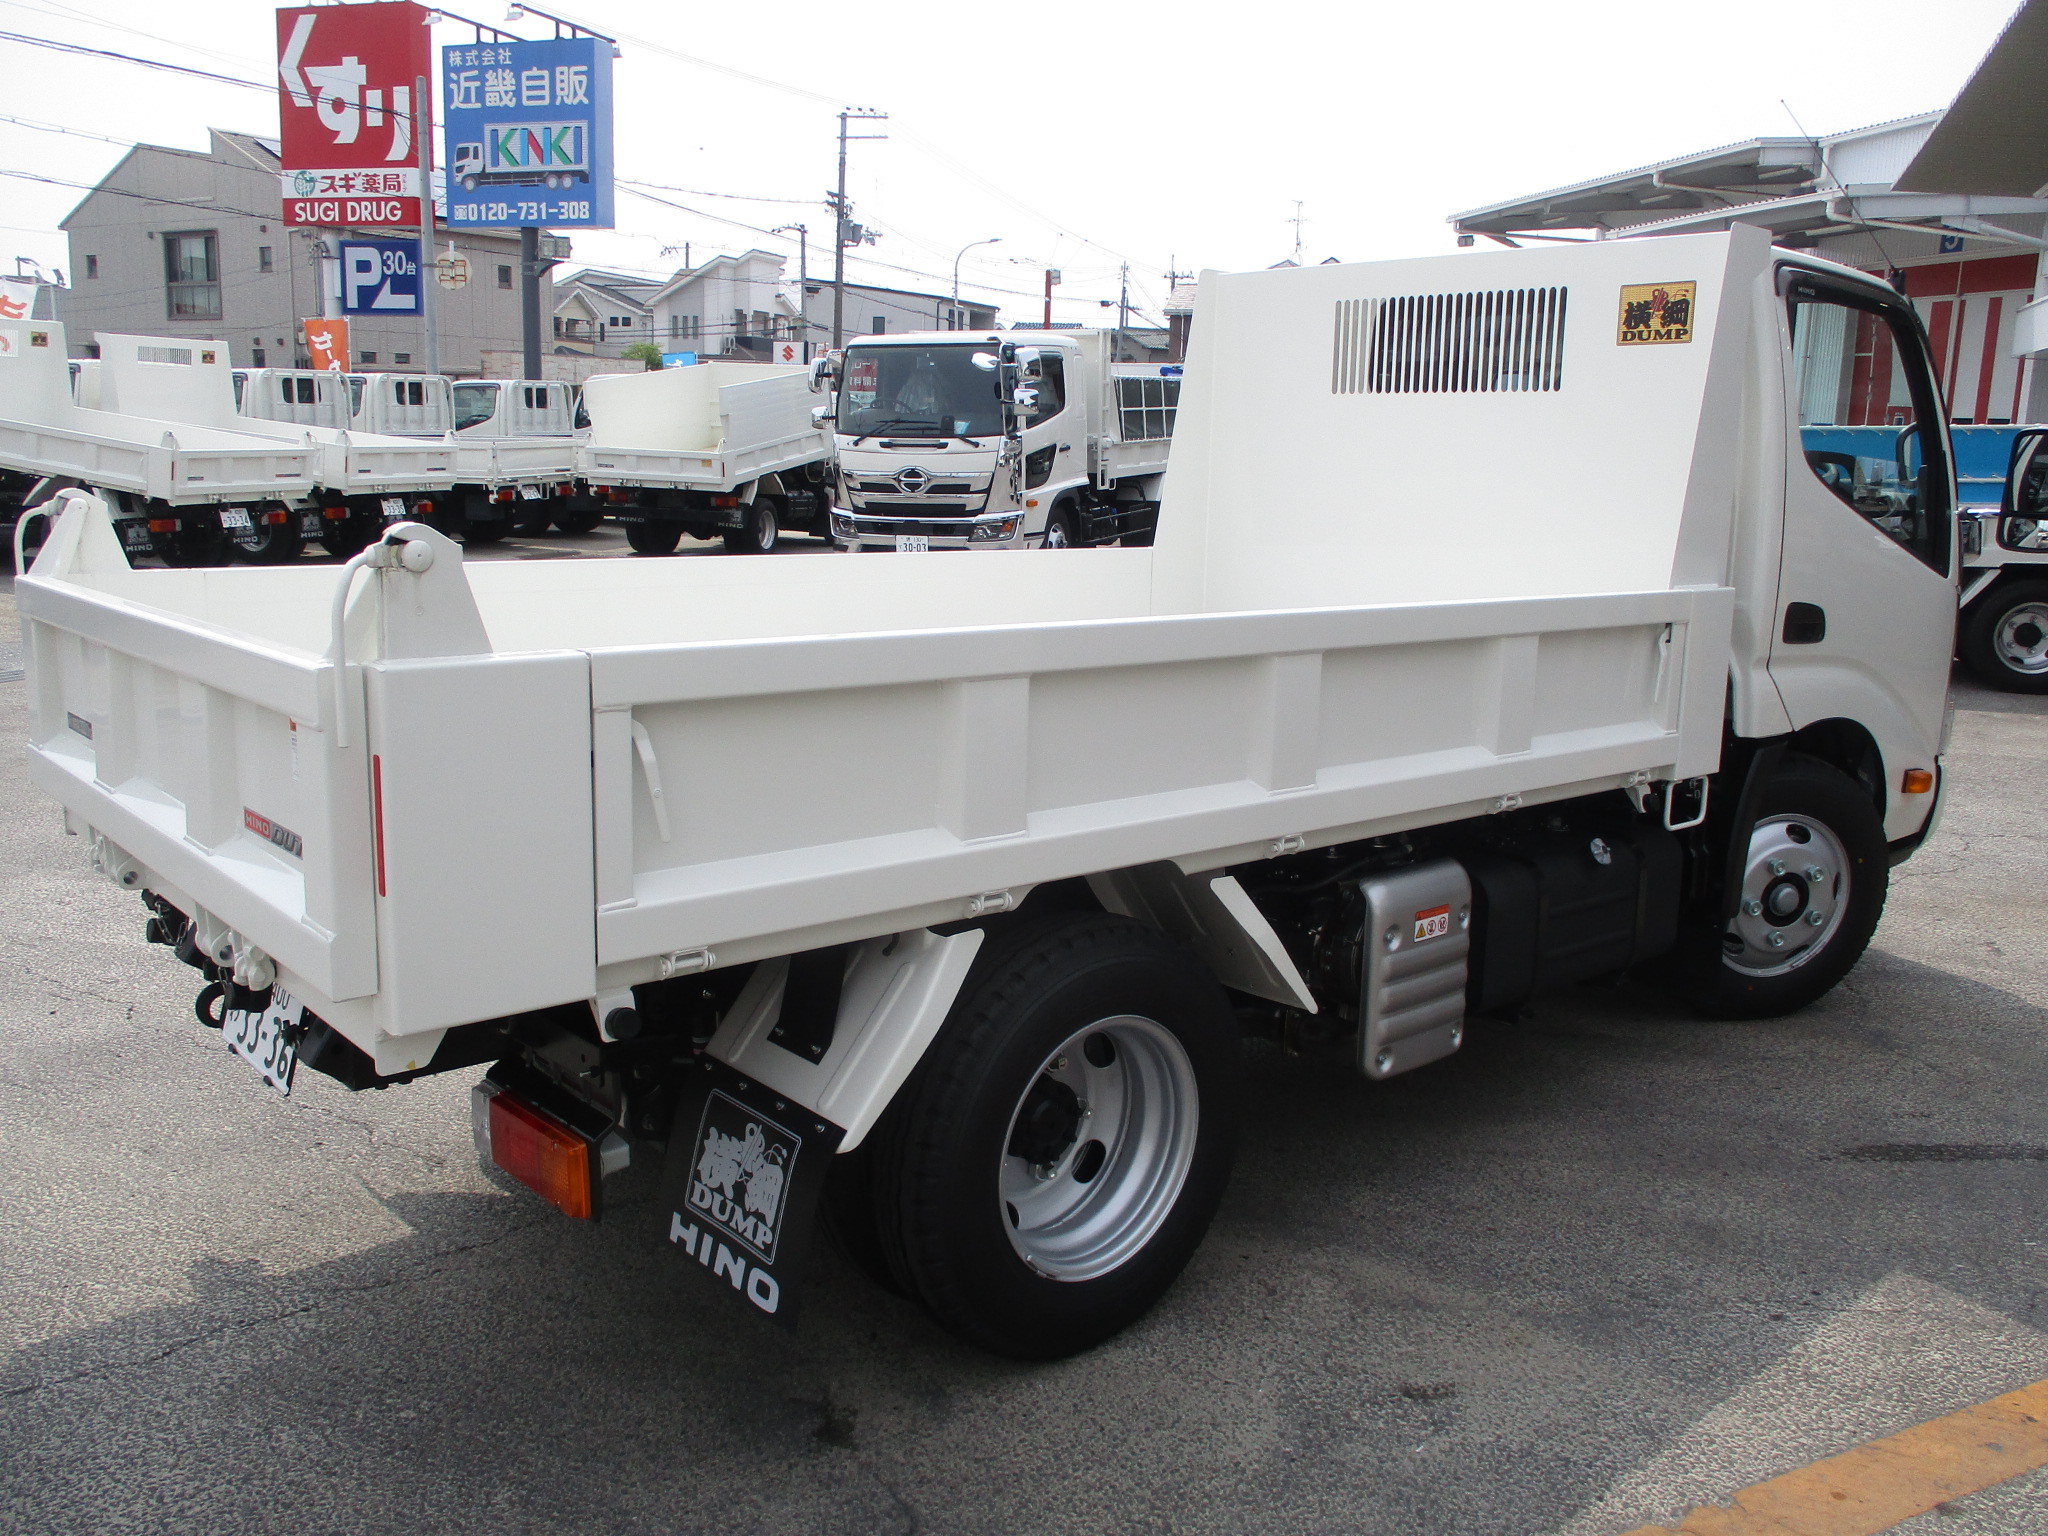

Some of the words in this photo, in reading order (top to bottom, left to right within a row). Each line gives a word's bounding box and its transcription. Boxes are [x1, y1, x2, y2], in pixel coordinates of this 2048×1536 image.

[449, 48, 513, 67] 株式会社
[279, 14, 410, 161] くすり
[449, 65, 589, 110] 近畿自販
[320, 172, 402, 193] スギ薬局
[295, 202, 339, 222] SUGI
[347, 201, 402, 221] DRUG
[468, 201, 590, 221] 0120-731-308
[344, 247, 382, 308] P
[1620, 328, 1689, 341] DUMP
[903, 543, 927, 552] 30-03
[245, 812, 270, 836] HINO
[690, 1180, 773, 1250] DUMP
[669, 1211, 780, 1314] HINO
